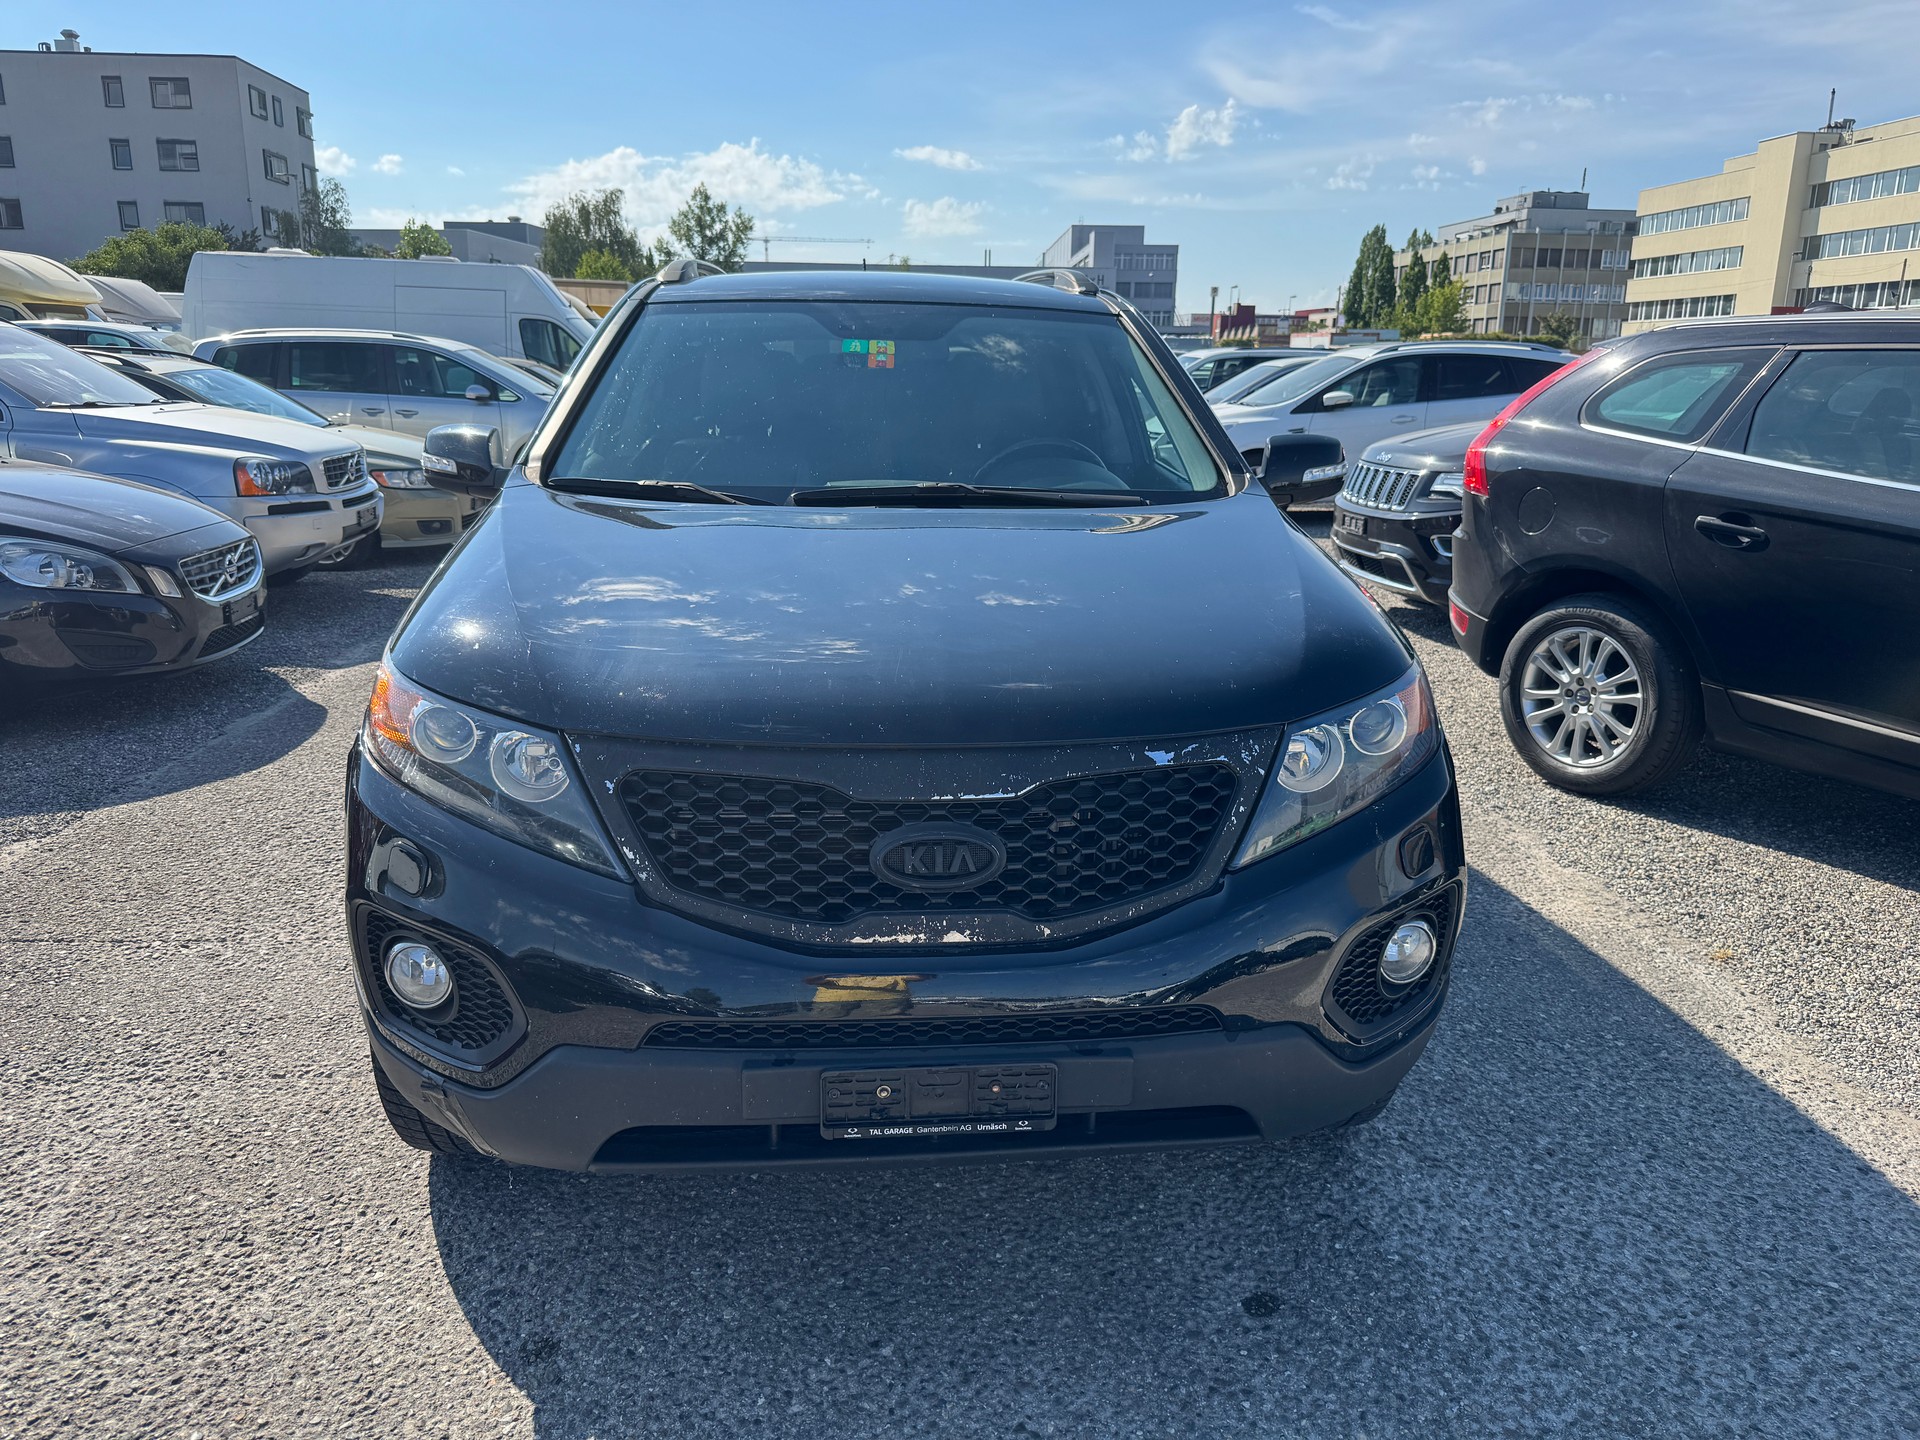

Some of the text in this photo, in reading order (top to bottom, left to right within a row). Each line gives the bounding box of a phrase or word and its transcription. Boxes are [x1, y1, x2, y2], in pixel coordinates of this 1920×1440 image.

[902, 845, 977, 873] KIA
[884, 1127, 913, 1135] GARAGE
[960, 1124, 972, 1132] AG
[977, 1123, 1008, 1131] Urnäsch
